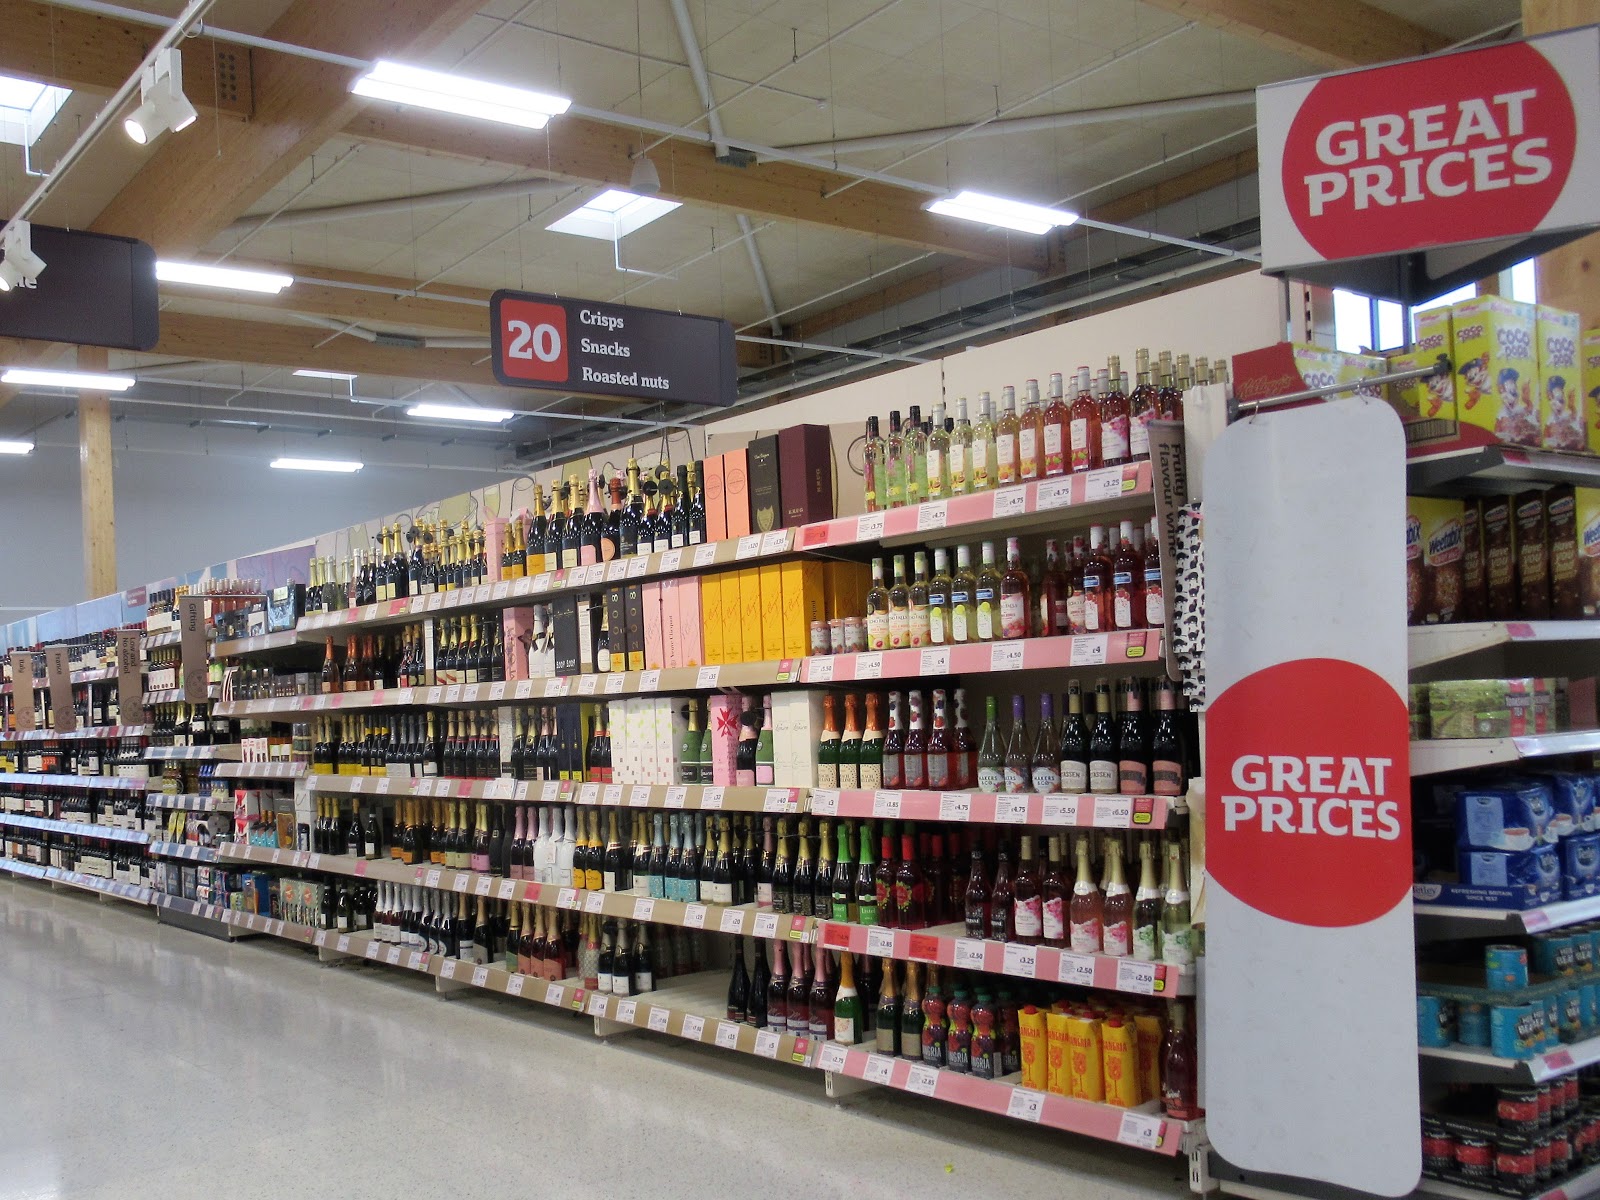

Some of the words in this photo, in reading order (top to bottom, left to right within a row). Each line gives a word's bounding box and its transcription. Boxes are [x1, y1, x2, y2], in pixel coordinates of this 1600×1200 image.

[1315, 88, 1537, 166] GREAT
[1304, 137, 1553, 217] PRICES
[580, 310, 625, 331] Crisps
[508, 320, 562, 363] 20
[581, 338, 631, 358] Snacks
[582, 367, 638, 386] Roasted
[641, 376, 670, 390] nuts
[1103, 479, 1120, 488] £3.25
[1171, 443, 1185, 497] Fruity
[1158, 443, 1173, 508] flavour
[1166, 516, 1177, 558] wine
[1429, 526, 1461, 556] Weetabix
[188, 603, 198, 632] Gifting
[1231, 755, 1393, 796] GREAT
[1221, 795, 1401, 841] PRICES
[1412, 884, 1437, 896] etley
[1076, 967, 1093, 975] £2.50
[1136, 975, 1153, 983] £2.50
